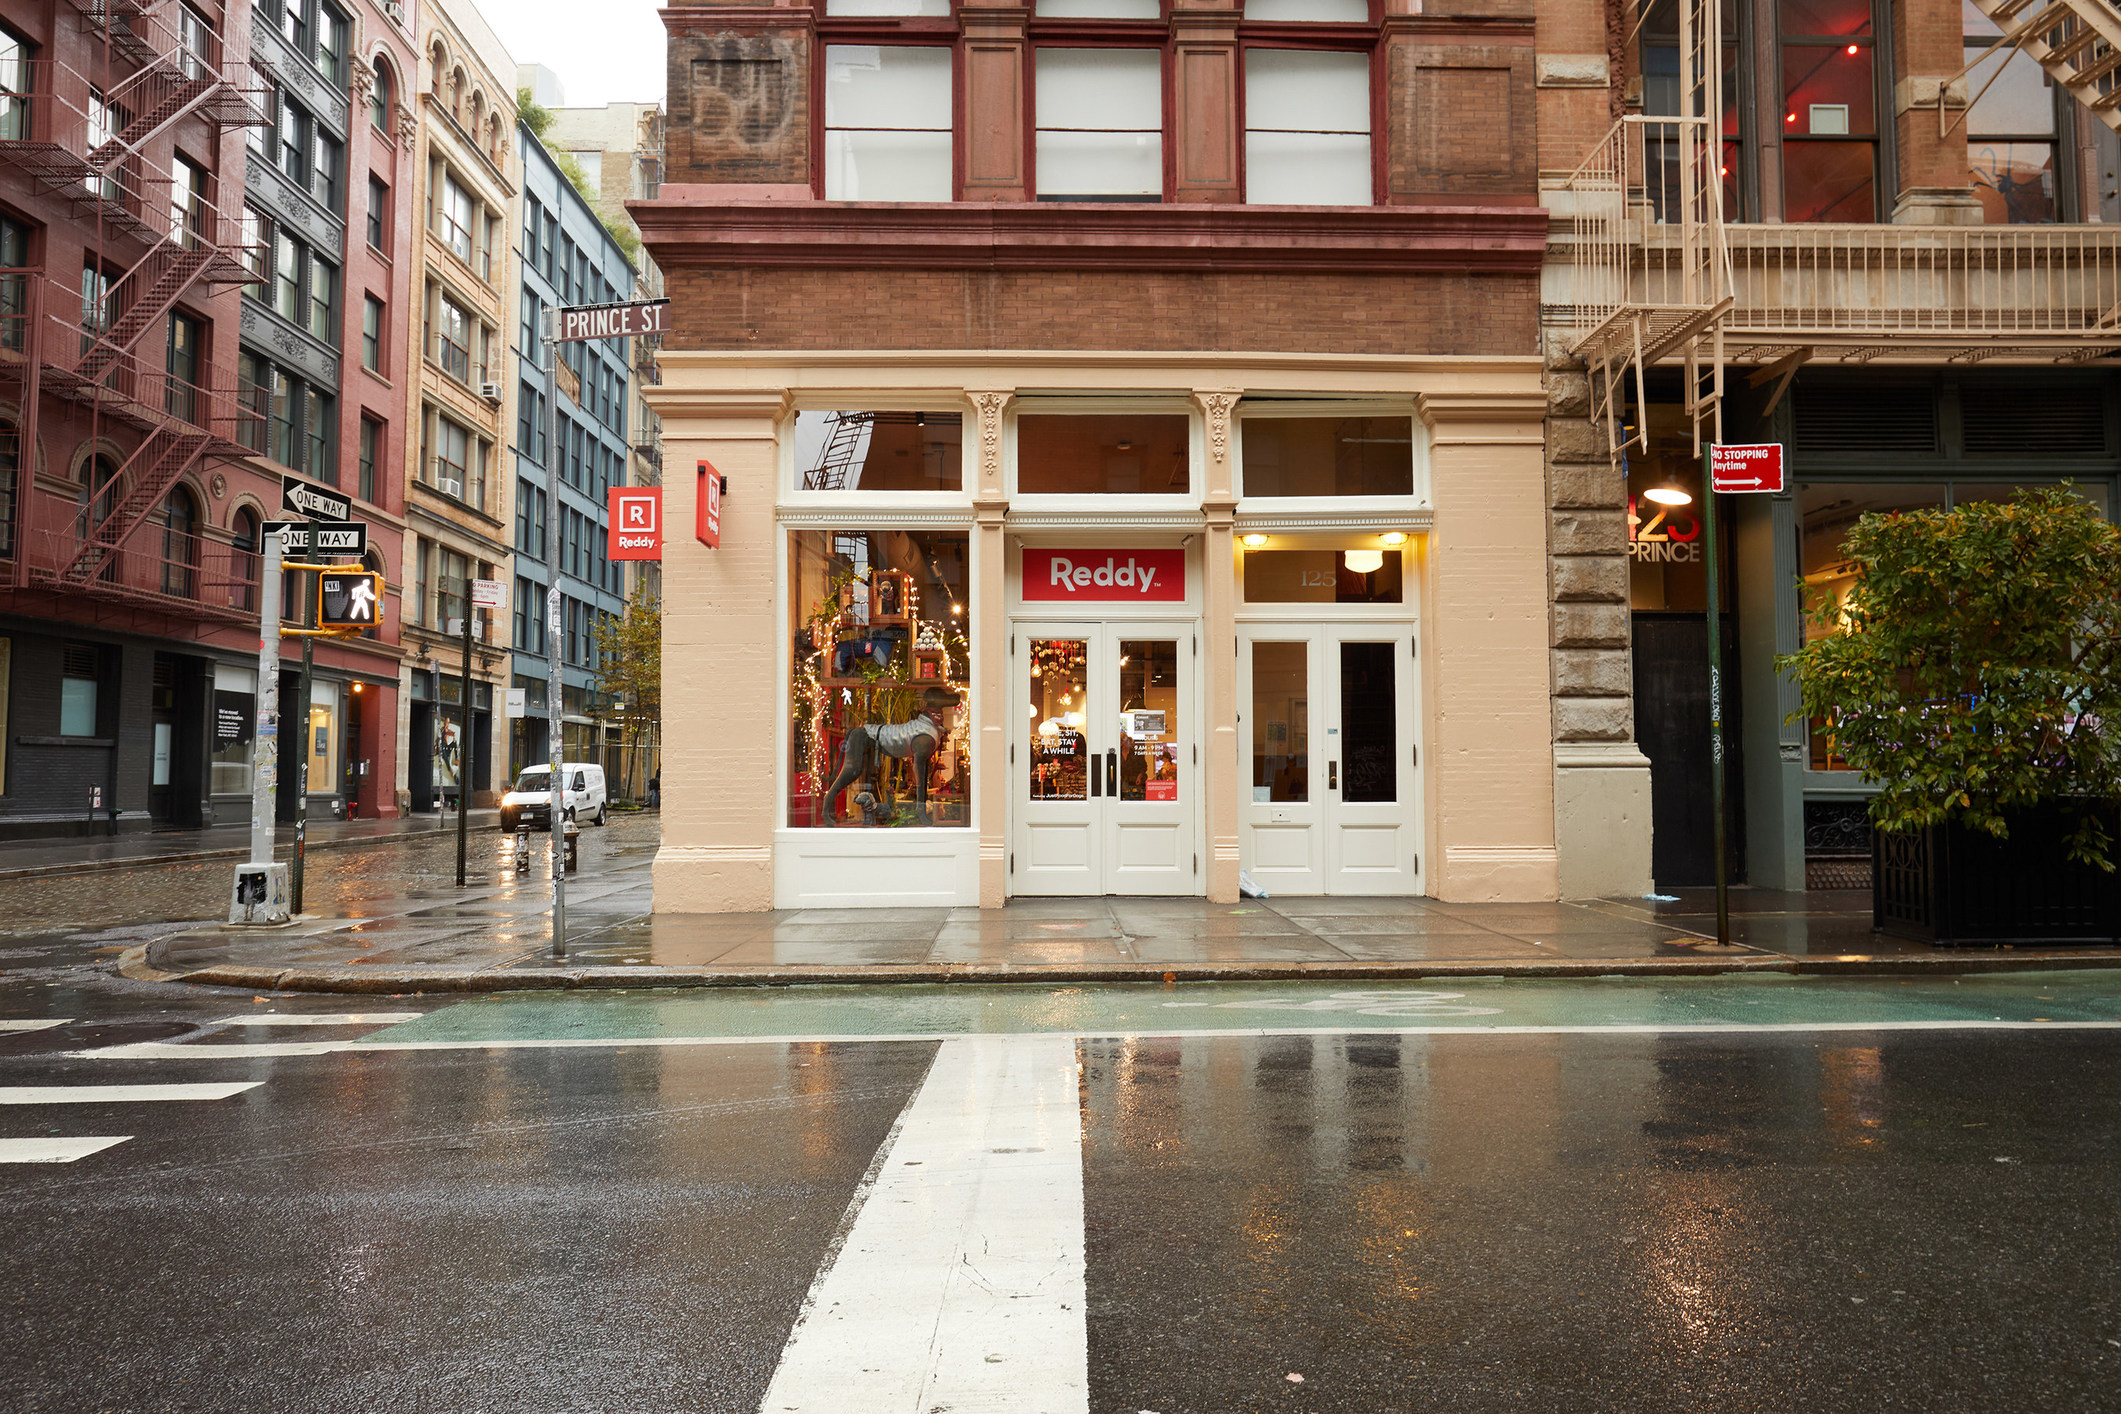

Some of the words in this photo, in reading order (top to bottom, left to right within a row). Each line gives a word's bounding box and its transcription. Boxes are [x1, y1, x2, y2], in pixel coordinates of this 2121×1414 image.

[566, 309, 632, 338] PRINCE
[641, 305, 663, 332] ST
[1714, 451, 1723, 460] NO
[1724, 449, 1769, 460] STOPPING
[1714, 461, 1747, 472] Anytime
[296, 490, 318, 509] ONE
[322, 499, 343, 517] WAY
[630, 506, 645, 525] R
[282, 532, 309, 545] ONE
[320, 533, 351, 545] WAY
[618, 536, 655, 549] Reddy
[1628, 542, 1700, 563] PRINCE
[1050, 557, 1157, 593] Reddy
[1301, 571, 1338, 587] 125
[1065, 730, 1079, 738] SIT,
[1058, 738, 1077, 746] STAY
[1043, 747, 1049, 755] A
[1050, 747, 1075, 755] WHILE
